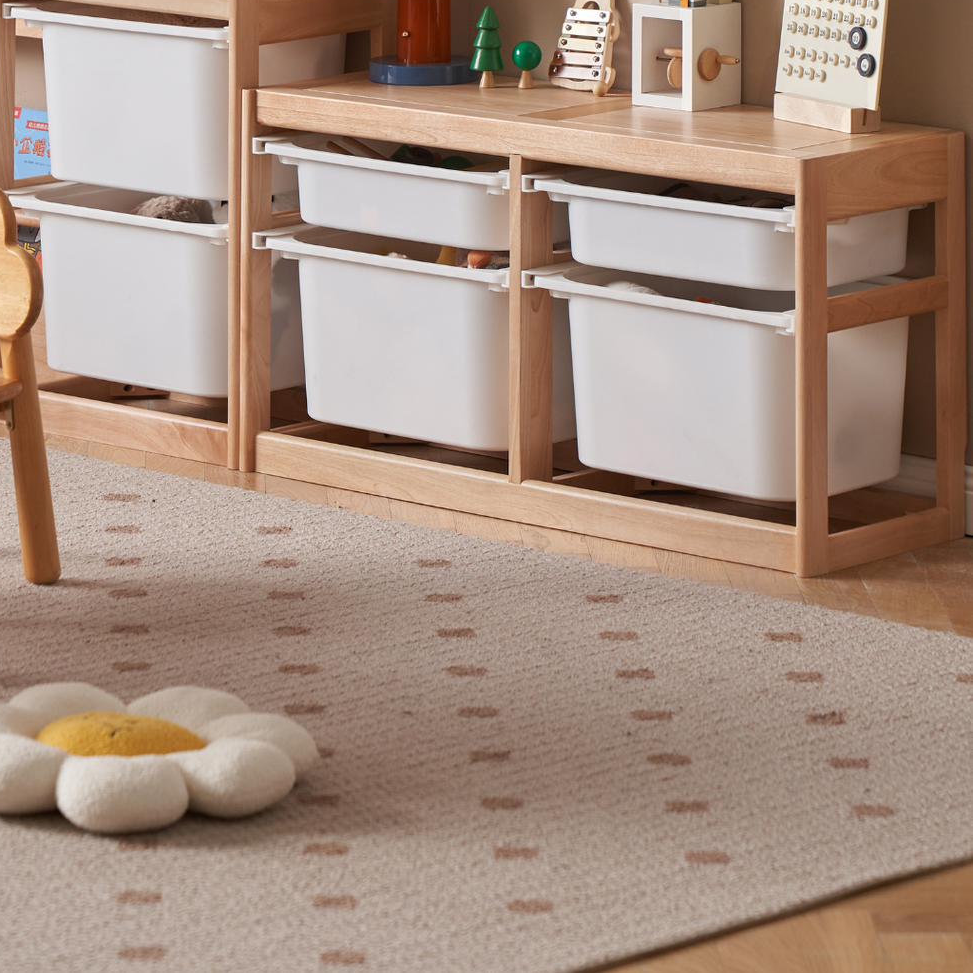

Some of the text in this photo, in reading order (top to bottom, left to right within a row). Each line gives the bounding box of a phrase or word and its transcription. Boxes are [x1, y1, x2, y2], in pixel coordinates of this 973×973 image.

[855, 16, 860, 24] 23
[866, 18, 871, 26] 24
[787, 23, 793, 31] 25
[798, 25, 804, 33] 26
[831, 31, 837, 39] 29
